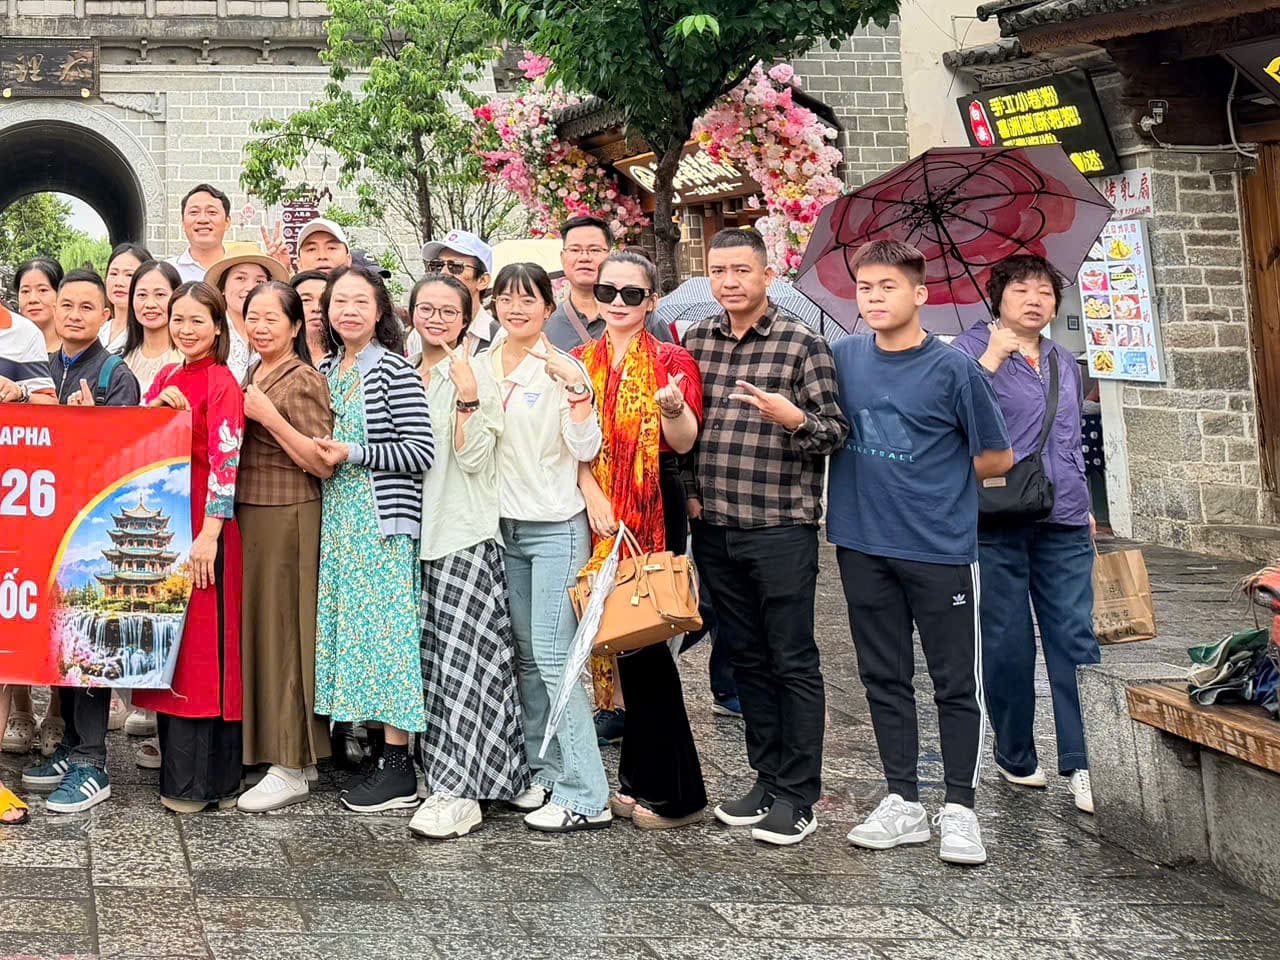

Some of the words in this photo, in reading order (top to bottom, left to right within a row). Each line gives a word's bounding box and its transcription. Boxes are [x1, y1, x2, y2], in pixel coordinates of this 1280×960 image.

[988, 84, 1059, 117] 手工小卷粉
[846, 444, 916, 463] ASKETBALL
